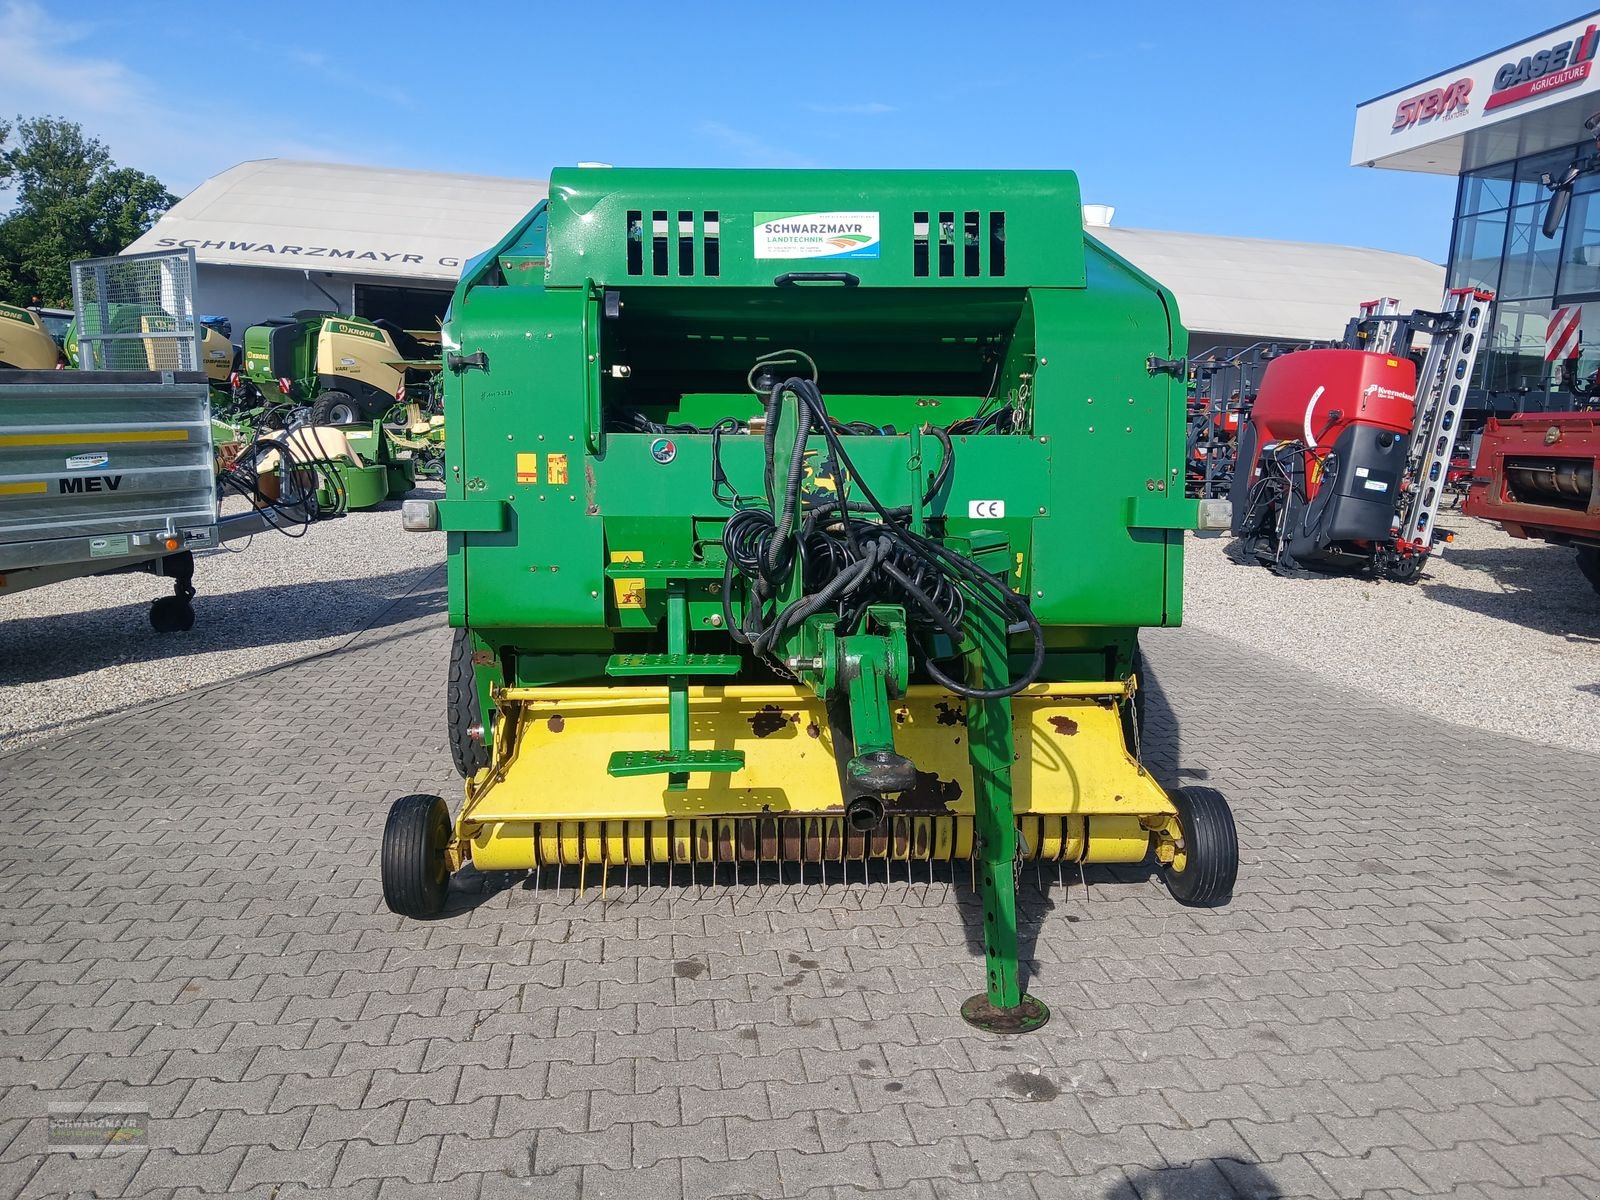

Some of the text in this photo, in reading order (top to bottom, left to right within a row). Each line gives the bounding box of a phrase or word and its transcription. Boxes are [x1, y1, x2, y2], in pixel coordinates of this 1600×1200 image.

[1493, 41, 1573, 90] CASE
[1530, 65, 1585, 93] AGRICULTURE
[1392, 78, 1473, 129] STEYR
[765, 224, 862, 234] SCHWARZMAYR
[155, 238, 423, 264] SCHWARZMAYR
[348, 328, 375, 338] KRONE
[1378, 386, 1415, 402] Kverneland
[59, 475, 122, 494] MEV
[976, 502, 998, 517] CE
